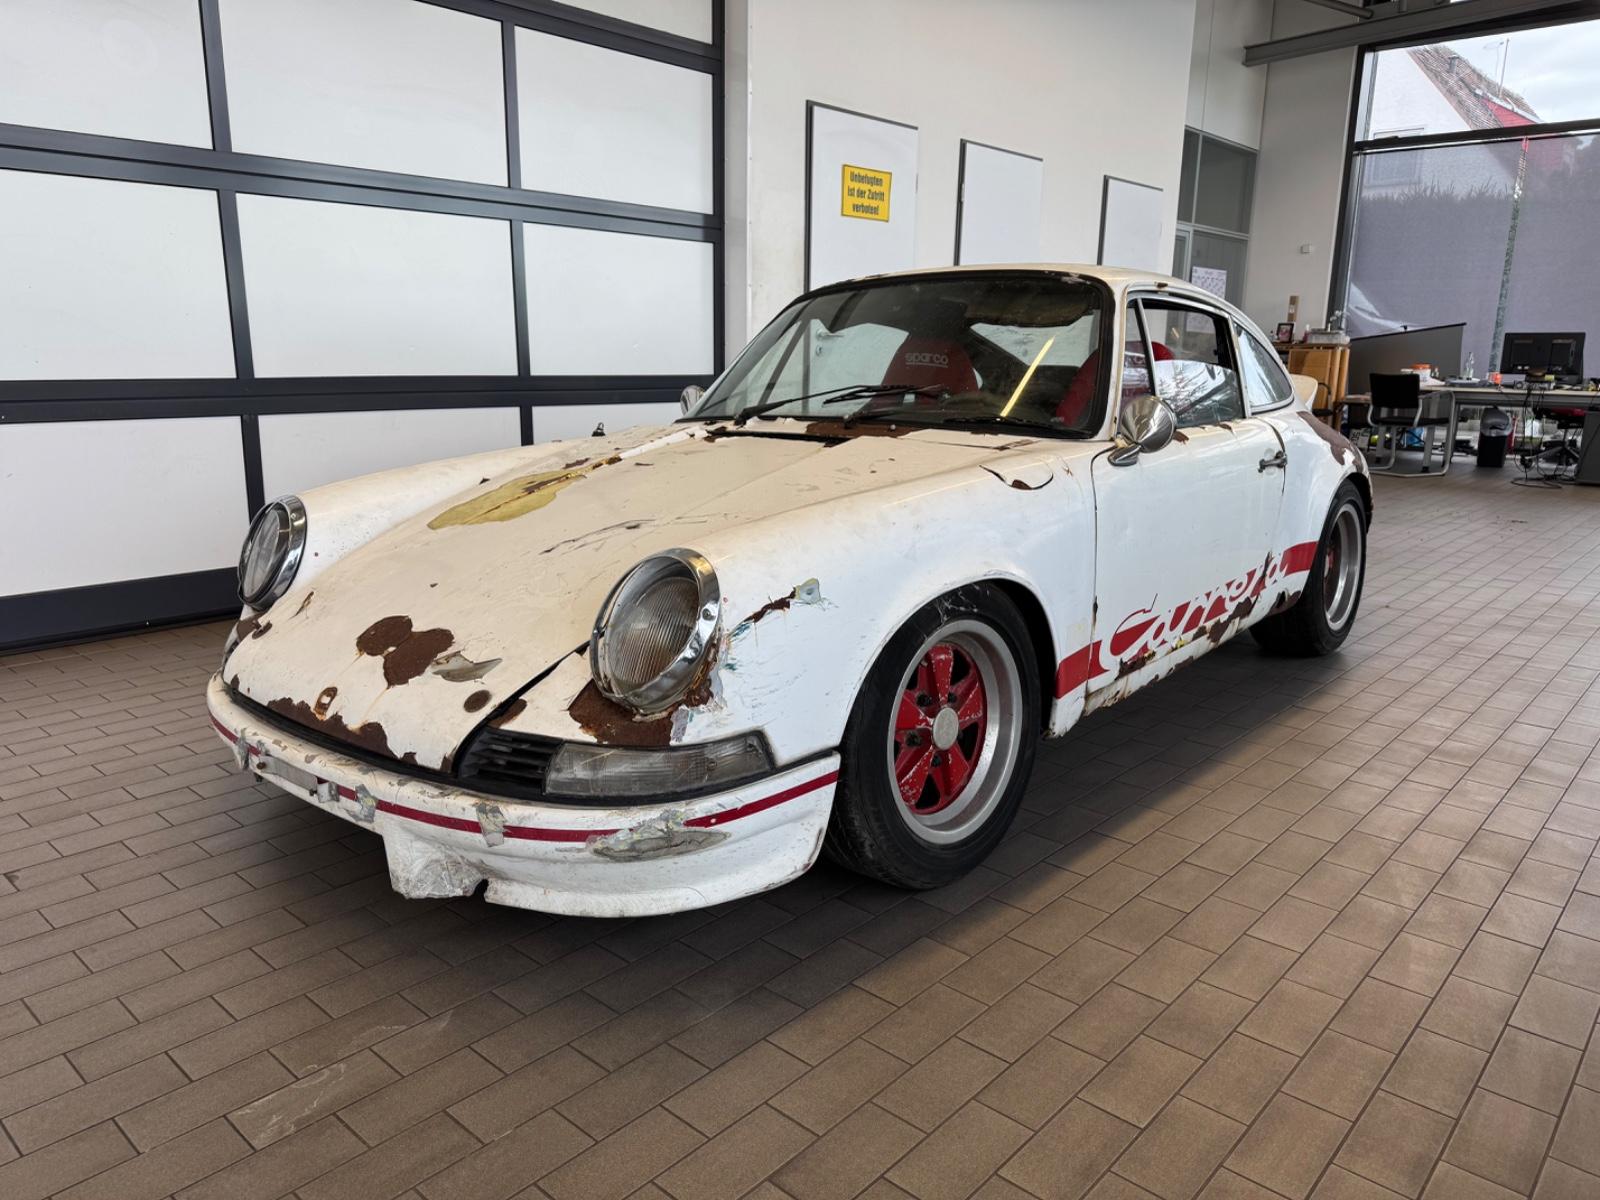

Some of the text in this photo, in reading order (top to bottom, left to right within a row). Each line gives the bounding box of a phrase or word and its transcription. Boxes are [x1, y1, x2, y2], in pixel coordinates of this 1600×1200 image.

[850, 171, 883, 186] Unbefugten
[857, 187, 866, 199] der
[868, 189, 885, 202] Zutritt
[853, 203, 880, 216] verboten!
[905, 352, 949, 364] sparco
